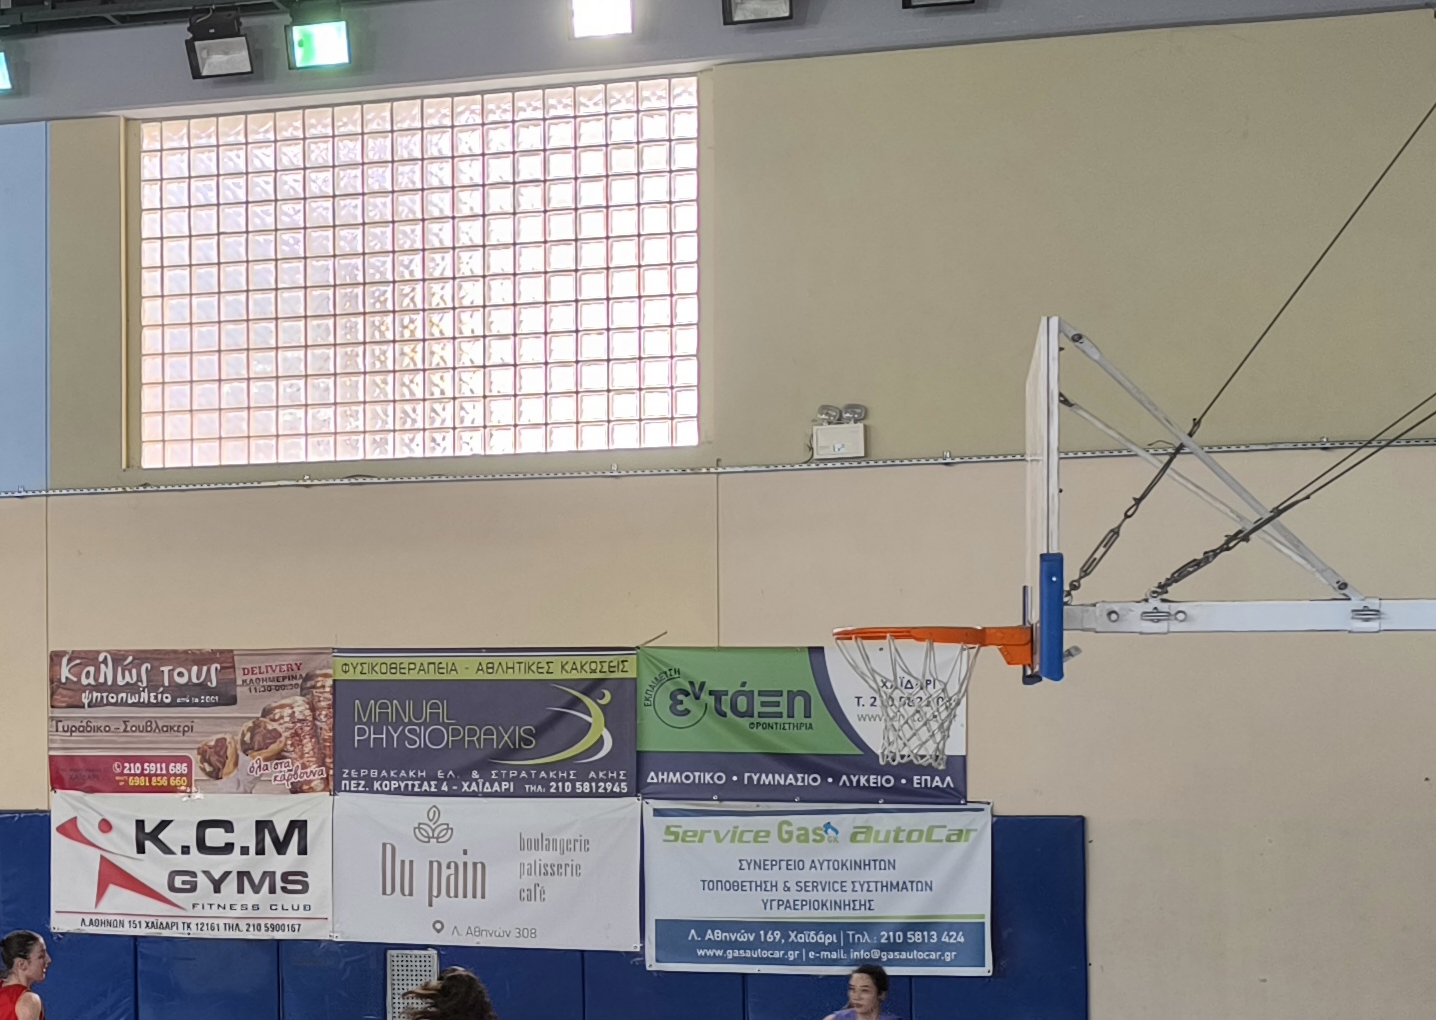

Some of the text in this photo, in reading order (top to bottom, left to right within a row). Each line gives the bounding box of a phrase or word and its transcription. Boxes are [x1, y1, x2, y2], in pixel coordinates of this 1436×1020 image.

[242, 662, 303, 676] DELIVERY
[341, 661, 459, 676] ΦΥΣΙΚΟΘΕΡΑΠΕΙΑ
[475, 660, 554, 675] ΑΘΛΗΤΙΚΕΣ
[560, 659, 629, 674] ΚΑΚΩΣΕΙΣ
[881, 676, 936, 689] ΧΪΔΡΙ
[354, 699, 456, 723] MANUAL
[55, 720, 112, 736] Γυράδικο
[122, 720, 194, 736] Σουβλακερί
[749, 722, 813, 731] ΦΡΟΝΤΙΣΤΗΡΙΑ
[354, 725, 536, 749] PHYSIOPRAXIS
[123, 763, 188, 774] 210 5911 686
[249, 757, 291, 775] όλα στα
[170, 776, 188, 786] 660
[272, 764, 325, 788] κάρβουνα
[341, 769, 627, 780] ΖΕΡΒΑΚΑΚΗ ΕΛ. & ΣΤΡΑΤΑΚΗΣ ΑΚΗΣ
[647, 771, 954, 788] ΔΗΜΟΤΙΚΟ ΓΥΜΝΑΣΙΟ ΛΥΚΕΙΟ ΕΠΑΛ
[341, 781, 369, 793] ΠΕΖ.
[373, 781, 438, 793] ΚΟΡΥΤΣΑΣ
[441, 781, 449, 792] 4
[461, 778, 514, 793] ΧΑΪΔΑΡΙ
[550, 781, 572, 793] 210
[576, 781, 628, 793] 5812945
[135, 818, 308, 855] K.C.M
[662, 824, 771, 844] Service
[777, 819, 825, 844] Gas
[519, 832, 590, 855] boulangerie
[519, 859, 581, 879] patisserie
[738, 859, 896, 871] ΣΥΝΕΡΓΕΙΟ ΑΥΤΟΚΙΝΗΤΩΝ
[167, 870, 310, 894] GYMS
[381, 842, 487, 907] Du pain
[519, 882, 546, 902] café
[700, 880, 933, 892] ΤΟΠΟΘΕΤΗΣΗ & SERVICE ΣΥΣΤΗΜΑΤΩΝ
[192, 903, 312, 912] FITNESS CLUB
[761, 899, 875, 911] ΥΓΡΑΕΡΙΟΚΙΝΗΣΗΣ
[128, 919, 142, 929] 151
[144, 918, 179, 931] ΧΑΪΔΑΡΙ
[181, 921, 192, 931] ΤΚ
[246, 922, 262, 933] 210
[264, 922, 302, 933] 5900167
[465, 926, 511, 939] Αθηνών
[515, 927, 537, 939] 308
[688, 929, 701, 941] Λ.
[705, 928, 755, 942] Αθηνών
[759, 929, 785, 944] 169,
[788, 929, 837, 946] Χαϊδάρι
[880, 931, 903, 943] 210
[907, 931, 937, 943] 5813
[941, 931, 964, 943] 424
[696, 948, 800, 961] www.gasautocar.gr
[850, 949, 956, 962] info@gasautocar.gr
